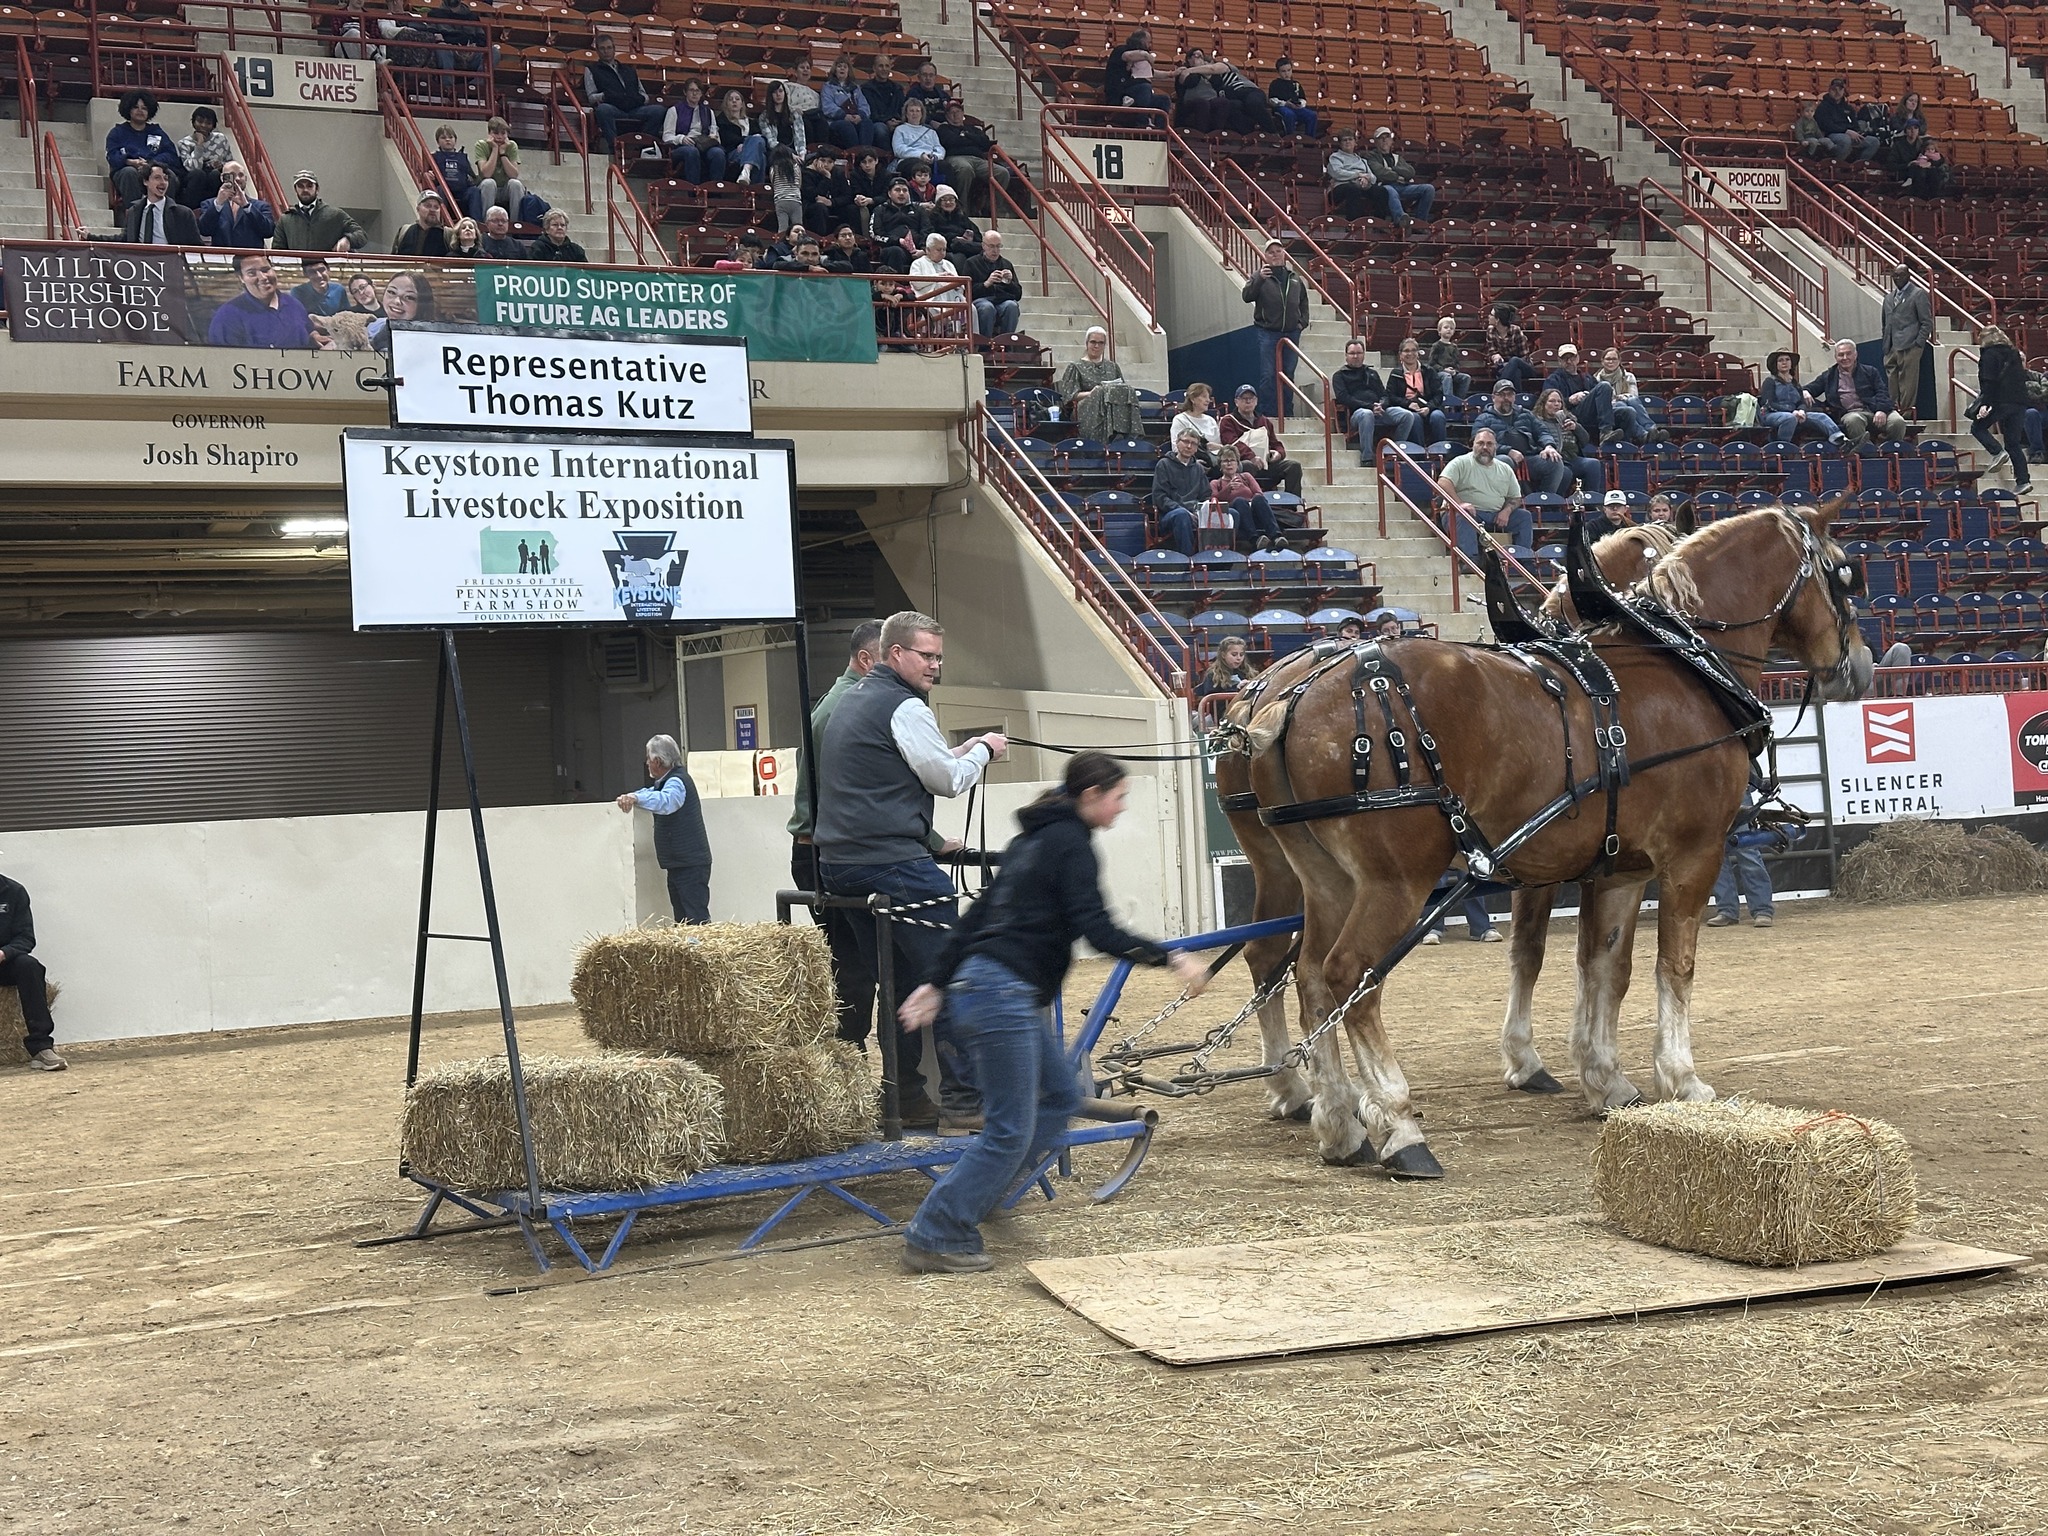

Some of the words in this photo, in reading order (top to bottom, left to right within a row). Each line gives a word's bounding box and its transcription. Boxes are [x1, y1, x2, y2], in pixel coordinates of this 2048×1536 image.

[234, 57, 274, 98] 19
[295, 61, 364, 82] FUNNEL
[300, 82, 358, 103] CAKES
[1092, 144, 1123, 179] 18
[1692, 170, 1717, 203] 17
[1729, 172, 1780, 187] POPCORN
[20, 256, 166, 282] MILTON
[23, 281, 166, 307] HERSHEY
[494, 274, 570, 298] PROUD
[577, 279, 704, 303] SUPPORTER
[710, 283, 737, 304] OF
[496, 301, 584, 325] FUTURE
[590, 305, 620, 327] AG
[627, 307, 729, 329] LEADERS
[117, 361, 209, 388] FARM
[233, 363, 334, 391] SHOW
[355, 367, 386, 392] C
[442, 346, 707, 383] Representative
[459, 384, 604, 417] Thomas
[617, 390, 695, 420] Kutz
[172, 414, 266, 429] GOVERNOR
[143, 443, 198, 466] Josh
[207, 444, 299, 473] Shapiro
[381, 445, 540, 484] Keystone
[550, 448, 759, 480] International
[404, 488, 568, 519] Livestock
[577, 490, 744, 527] Exposition
[456, 588, 583, 599] PENNSYLVANIA
[463, 600, 515, 611] FARM
[526, 600, 579, 610] SHOW
[613, 585, 683, 610] KEYSTONE
[1841, 773, 1943, 793] SILENCER
[1847, 795, 1940, 815] CENTRAL
